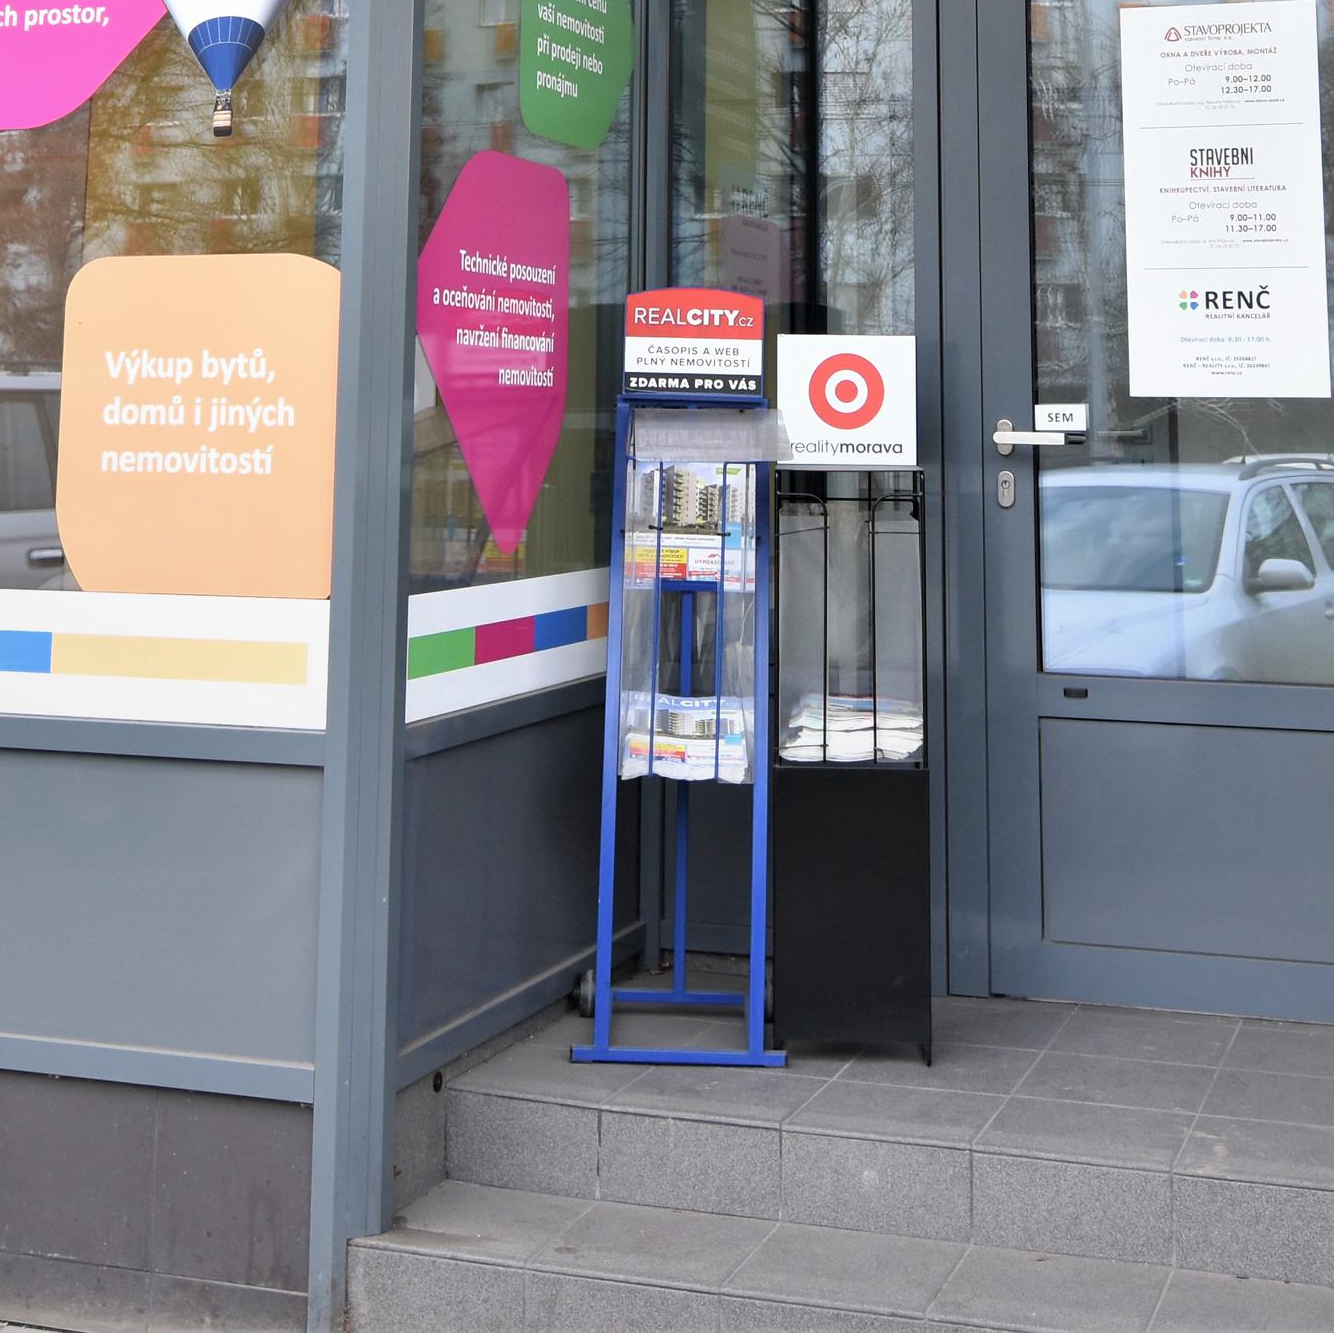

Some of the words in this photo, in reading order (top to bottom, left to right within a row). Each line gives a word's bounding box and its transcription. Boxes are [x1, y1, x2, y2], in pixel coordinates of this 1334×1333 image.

[24, 4, 109, 32] prostor,
[537, 2, 555, 24] vaší
[1184, 22, 1272, 36] STAVOPROJEKTA
[537, 33, 550, 57] při
[551, 43, 581, 71] prodeji
[582, 53, 603, 75] nebo
[1190, 49, 1212, 57] DVEŘE
[1247, 46, 1277, 55] MONTÁŽ
[1184, 62, 1226, 72] Otevírací
[1228, 62, 1253, 71] doba
[536, 70, 578, 98] pronájmu
[1190, 166, 1231, 178] KNIHY
[1213, 184, 1245, 192] STAVEBNÍ
[1247, 184, 1287, 192] LITERATURA
[1189, 200, 1230, 210] Otevírací
[1232, 200, 1257, 209] doba
[459, 249, 507, 278] Technické
[509, 262, 556, 285] posouzení
[433, 287, 440, 305] a
[442, 285, 496, 311] oceňování
[497, 296, 555, 322] nemovitostí,
[1205, 285, 1270, 309] RENČ
[634, 307, 754, 328] REALCITY.cz
[456, 324, 499, 348] navržení
[501, 327, 555, 353] financování
[647, 344, 699, 356] ČASOPIS
[702, 347, 711, 356] A
[715, 347, 740, 357] WEB
[105, 349, 194, 385] Výkup
[201, 348, 276, 385] bytů,
[636, 354, 667, 366] PLNÝ
[670, 355, 751, 369] NEMOVITOSTÍ
[498, 365, 554, 388] nemovitostí
[629, 376, 690, 389] ZDARMA
[694, 378, 724, 390] PRO
[728, 376, 757, 391] VÁS
[103, 395, 185, 426] domů
[194, 397, 201, 426] i
[207, 396, 295, 433] jiných
[1047, 412, 1074, 423] SEM
[791, 439, 903, 457] realitymorava
[100, 444, 275, 475] nemovitostí
